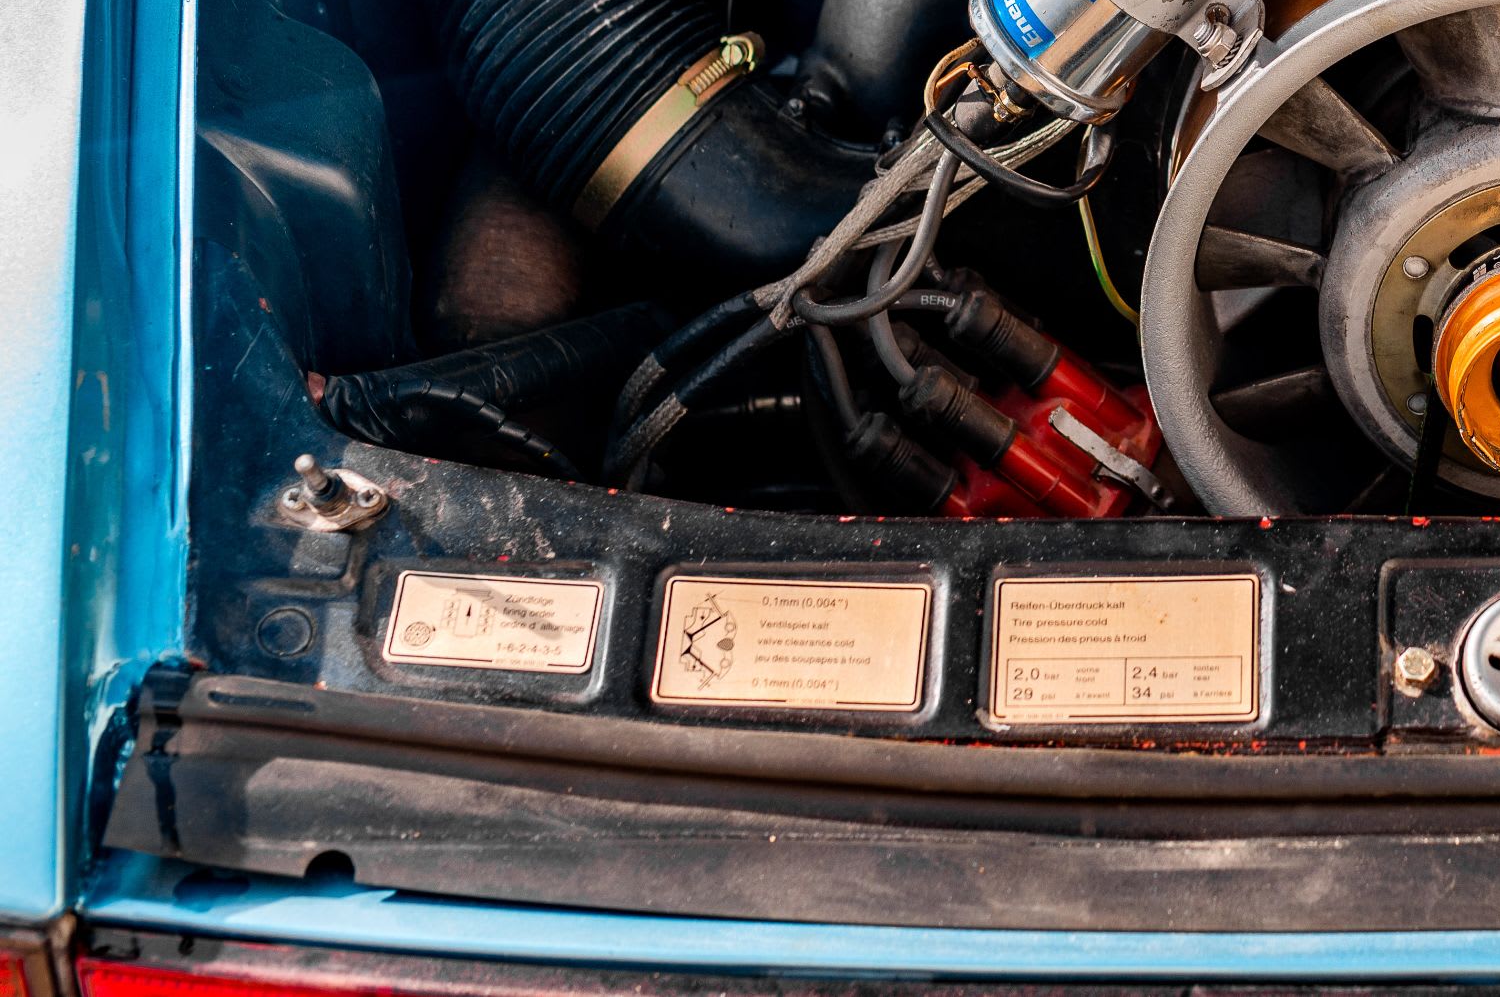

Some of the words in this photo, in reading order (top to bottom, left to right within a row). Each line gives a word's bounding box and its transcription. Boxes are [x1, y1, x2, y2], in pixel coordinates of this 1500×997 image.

[920, 295, 956, 308] BERU
[786, 315, 806, 329] BE
[759, 619, 810, 630] Ventilspiel
[1012, 618, 1032, 627] Tire
[1036, 618, 1083, 627] pressure
[1085, 617, 1107, 626] cold
[757, 637, 783, 645] valve
[784, 637, 832, 647] clearance
[834, 639, 855, 647] cold
[1009, 634, 1055, 643] Pression
[1057, 633, 1077, 643] des
[1079, 634, 1112, 644] pneus
[1122, 633, 1146, 642] froid
[754, 654, 770, 663] jeu
[771, 654, 790, 662] des
[790, 655, 838, 665] soupapes
[848, 656, 870, 664] froid
[1013, 667, 1039, 681] 2,0
[1132, 665, 1157, 680] 2,4
[1013, 687, 1033, 699] 29
[1132, 686, 1151, 699] 34
